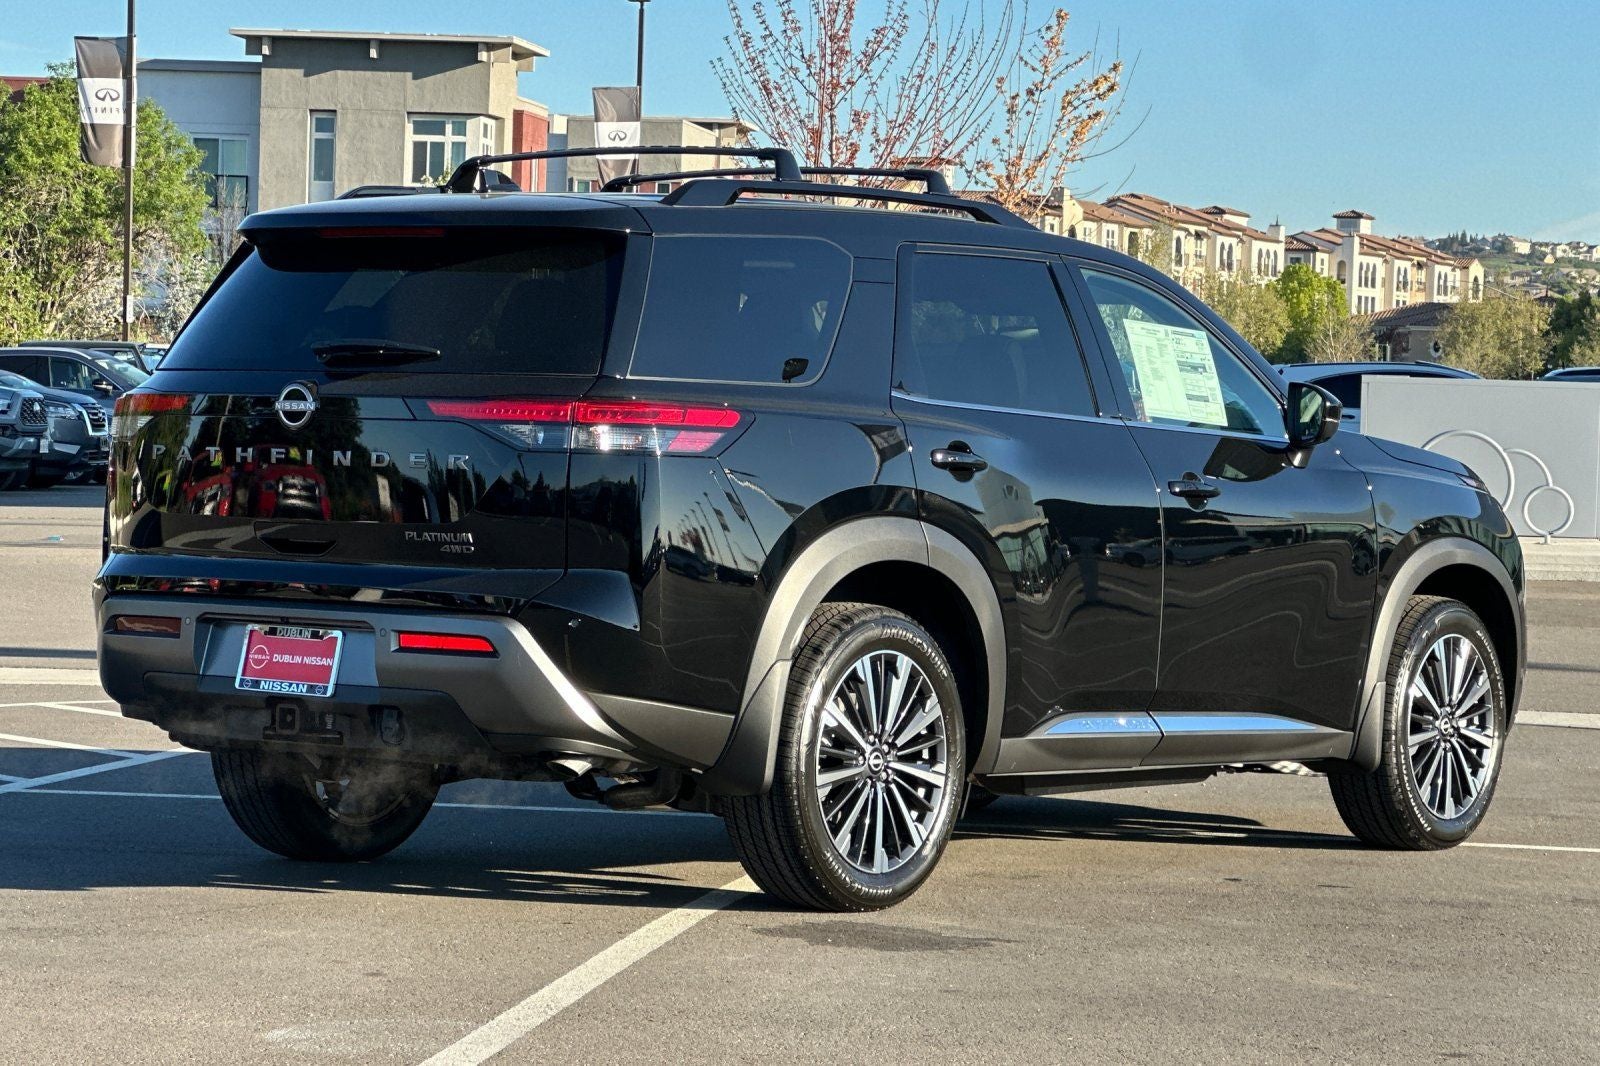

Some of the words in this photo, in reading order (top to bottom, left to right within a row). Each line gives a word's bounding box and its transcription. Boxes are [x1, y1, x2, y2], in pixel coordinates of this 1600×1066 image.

[275, 402, 314, 410] NISSAN
[150, 444, 470, 471] PATHFINDER
[404, 530, 473, 543] PLATINUM
[439, 544, 475, 554] 4WD
[276, 627, 312, 639] DUBLIN
[272, 653, 303, 664] DUBLIN
[303, 657, 334, 666] NISSAN
[259, 680, 308, 693] NISSAN
